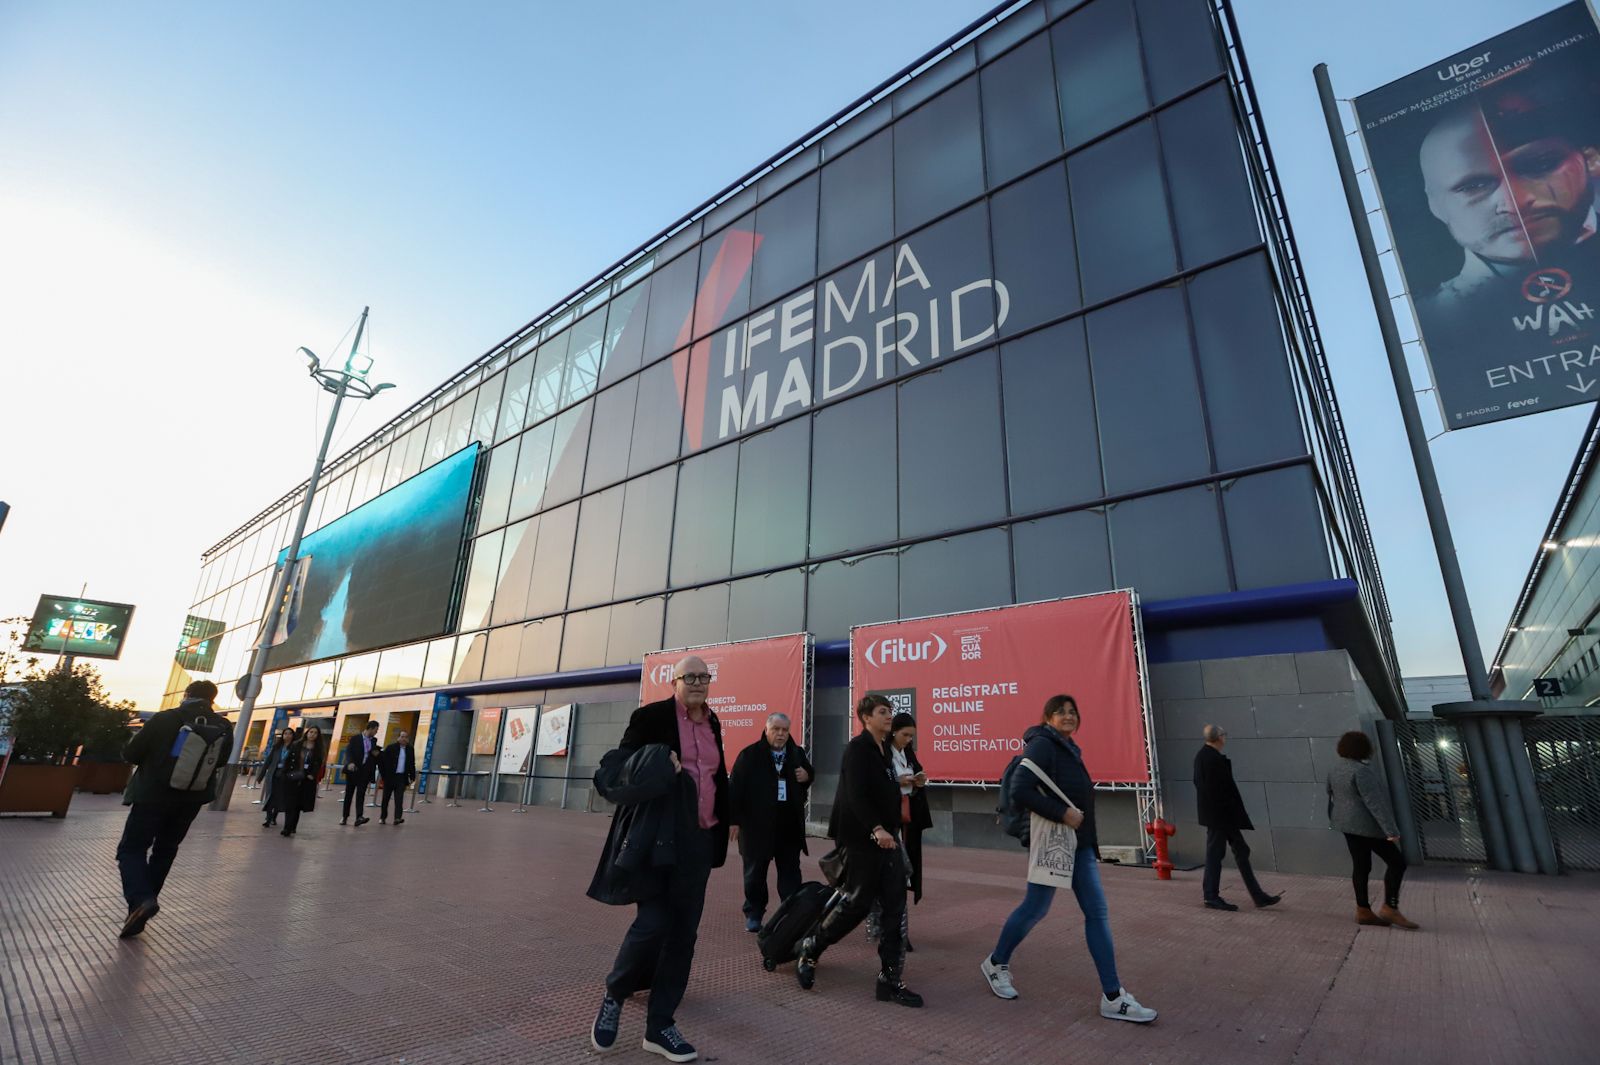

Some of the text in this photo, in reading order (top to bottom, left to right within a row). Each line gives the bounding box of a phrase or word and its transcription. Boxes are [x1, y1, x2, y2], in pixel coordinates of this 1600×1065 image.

[1437, 51, 1492, 81] Uber
[1366, 120, 1378, 130] EL
[1379, 106, 1408, 126] SHOW
[1432, 65, 1511, 102] ESPECTACULAR
[1513, 55, 1536, 69] DEL
[1421, 96, 1450, 112] HASTA
[723, 243, 931, 378] IFEMA
[1512, 301, 1595, 336] WAH
[718, 278, 1010, 439] MADRID
[1486, 344, 1600, 388] ENTRA
[1466, 397, 1540, 417] MADRID fever
[932, 682, 1018, 699] REGÍSTRATE
[1540, 681, 1555, 694] 2
[708, 696, 736, 705] DIRECTO
[720, 703, 767, 713] ACREDITADOS
[932, 700, 984, 714] ONLINE
[720, 719, 753, 728] TTENDEES
[933, 723, 981, 736] ONLINE
